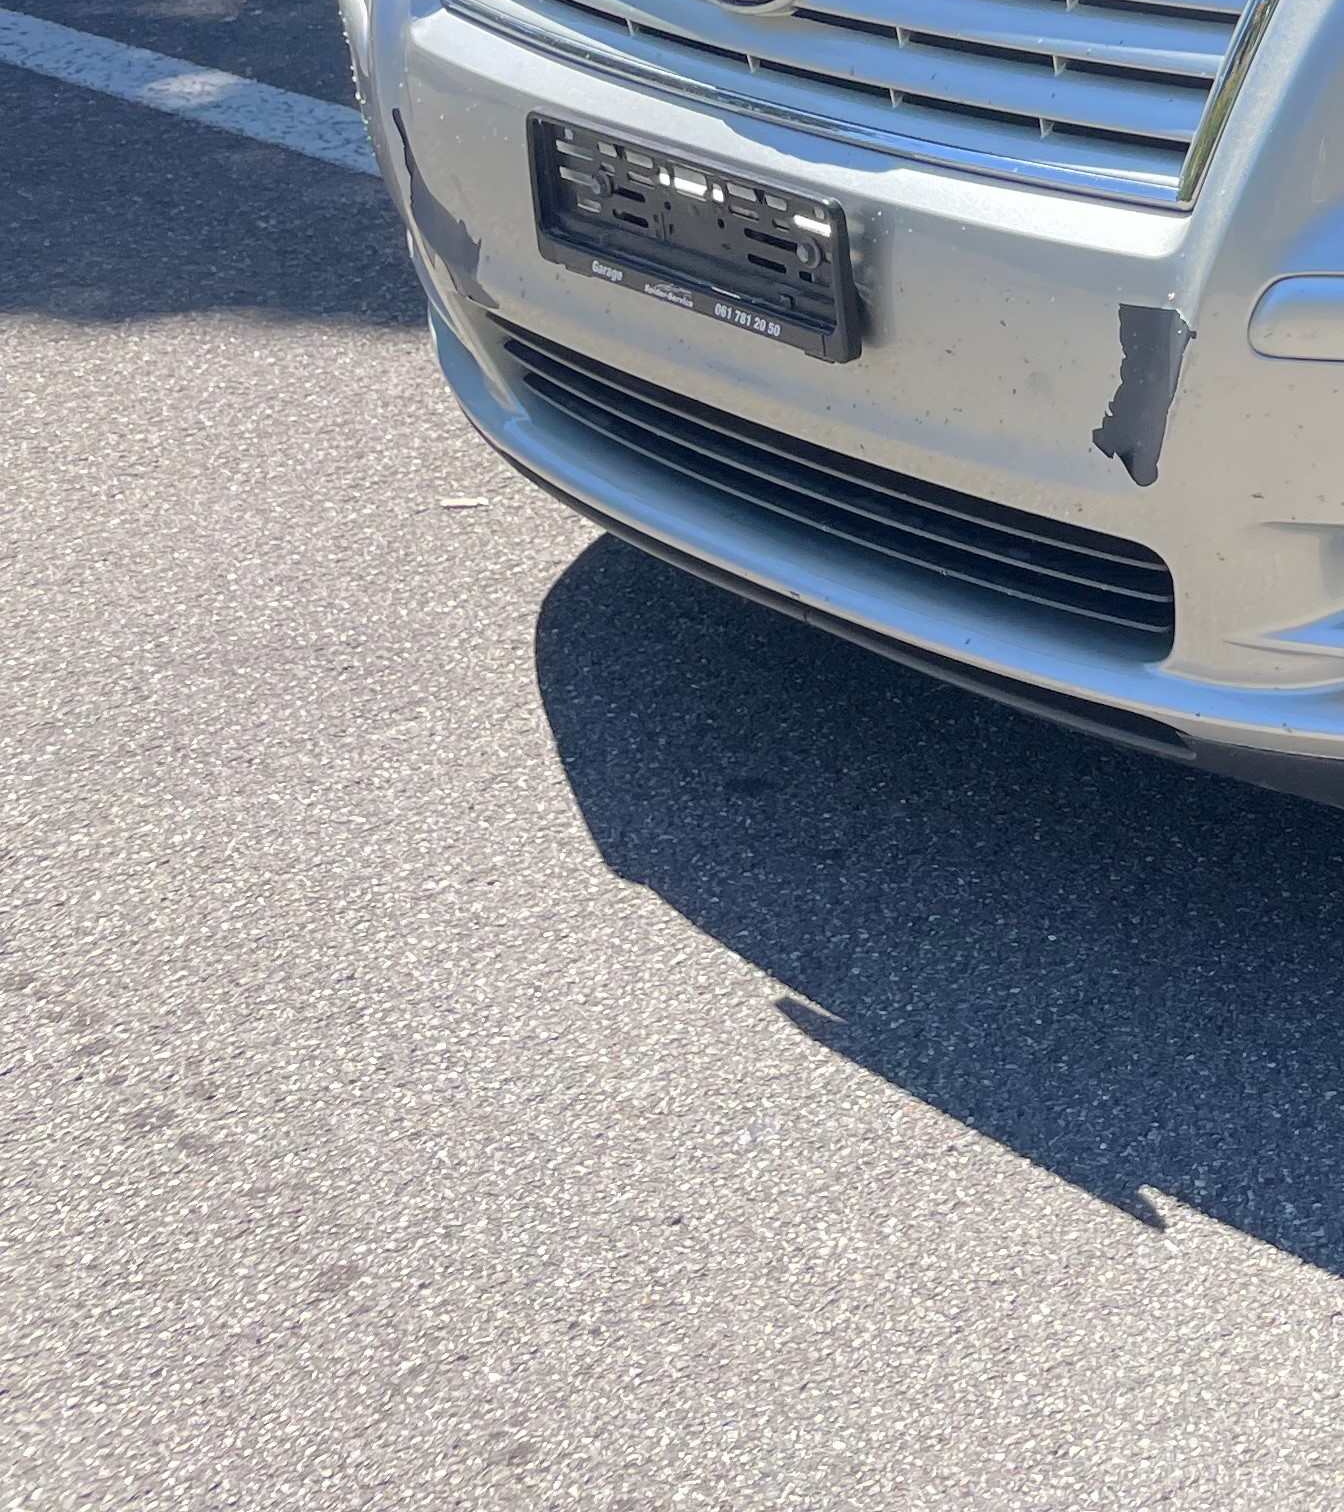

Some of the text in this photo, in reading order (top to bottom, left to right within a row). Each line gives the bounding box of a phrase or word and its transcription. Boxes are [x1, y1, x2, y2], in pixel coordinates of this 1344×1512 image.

[592, 260, 623, 282] Garage
[714, 303, 732, 320] 061
[734, 309, 752, 327] 781
[753, 317, 767, 332] 20
[767, 322, 781, 337] 50
